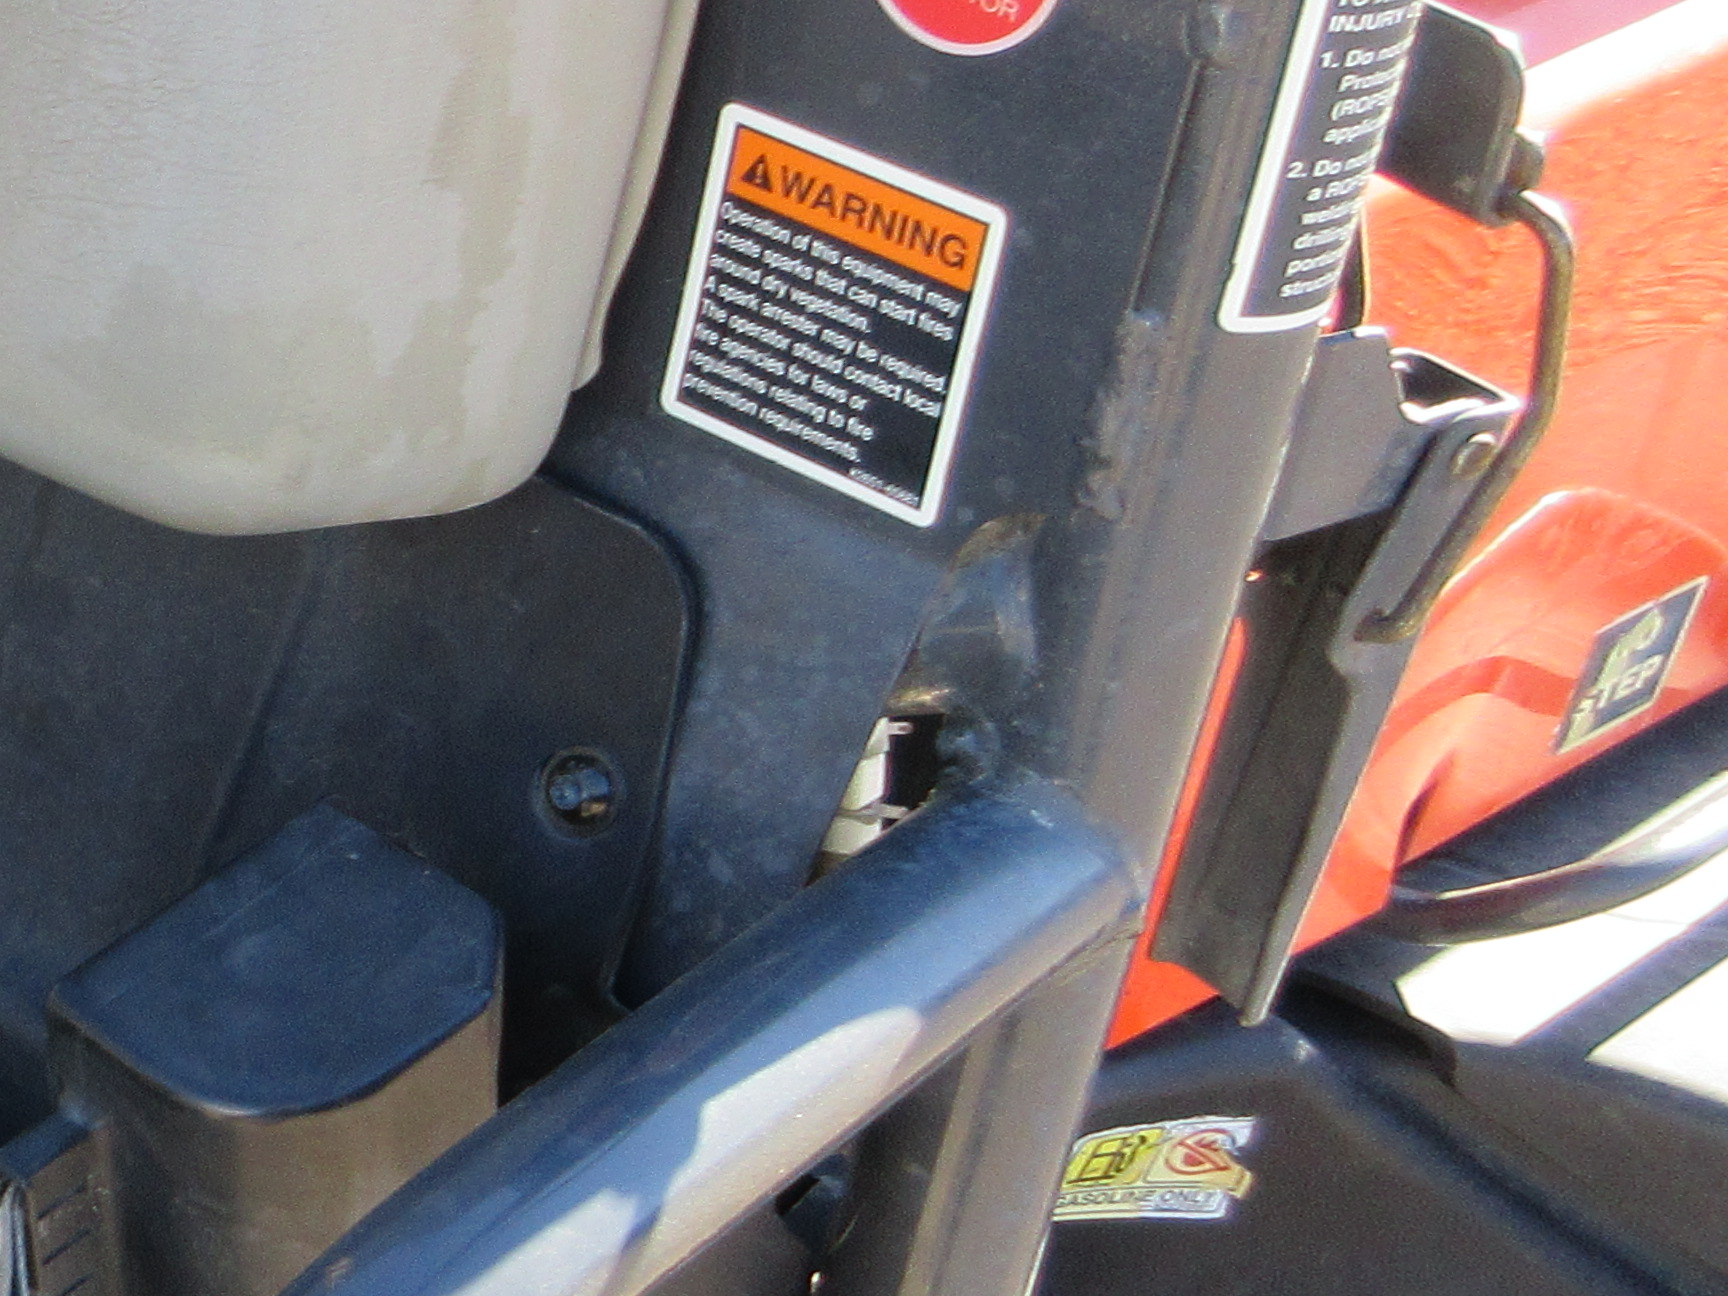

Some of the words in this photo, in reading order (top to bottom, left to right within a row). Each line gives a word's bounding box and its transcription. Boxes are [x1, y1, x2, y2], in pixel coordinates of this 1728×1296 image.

[1320, 51, 1341, 68] 1.
[1344, 49, 1376, 67] Do
[1286, 161, 1308, 178] 2.
[780, 164, 969, 268] WARNING
